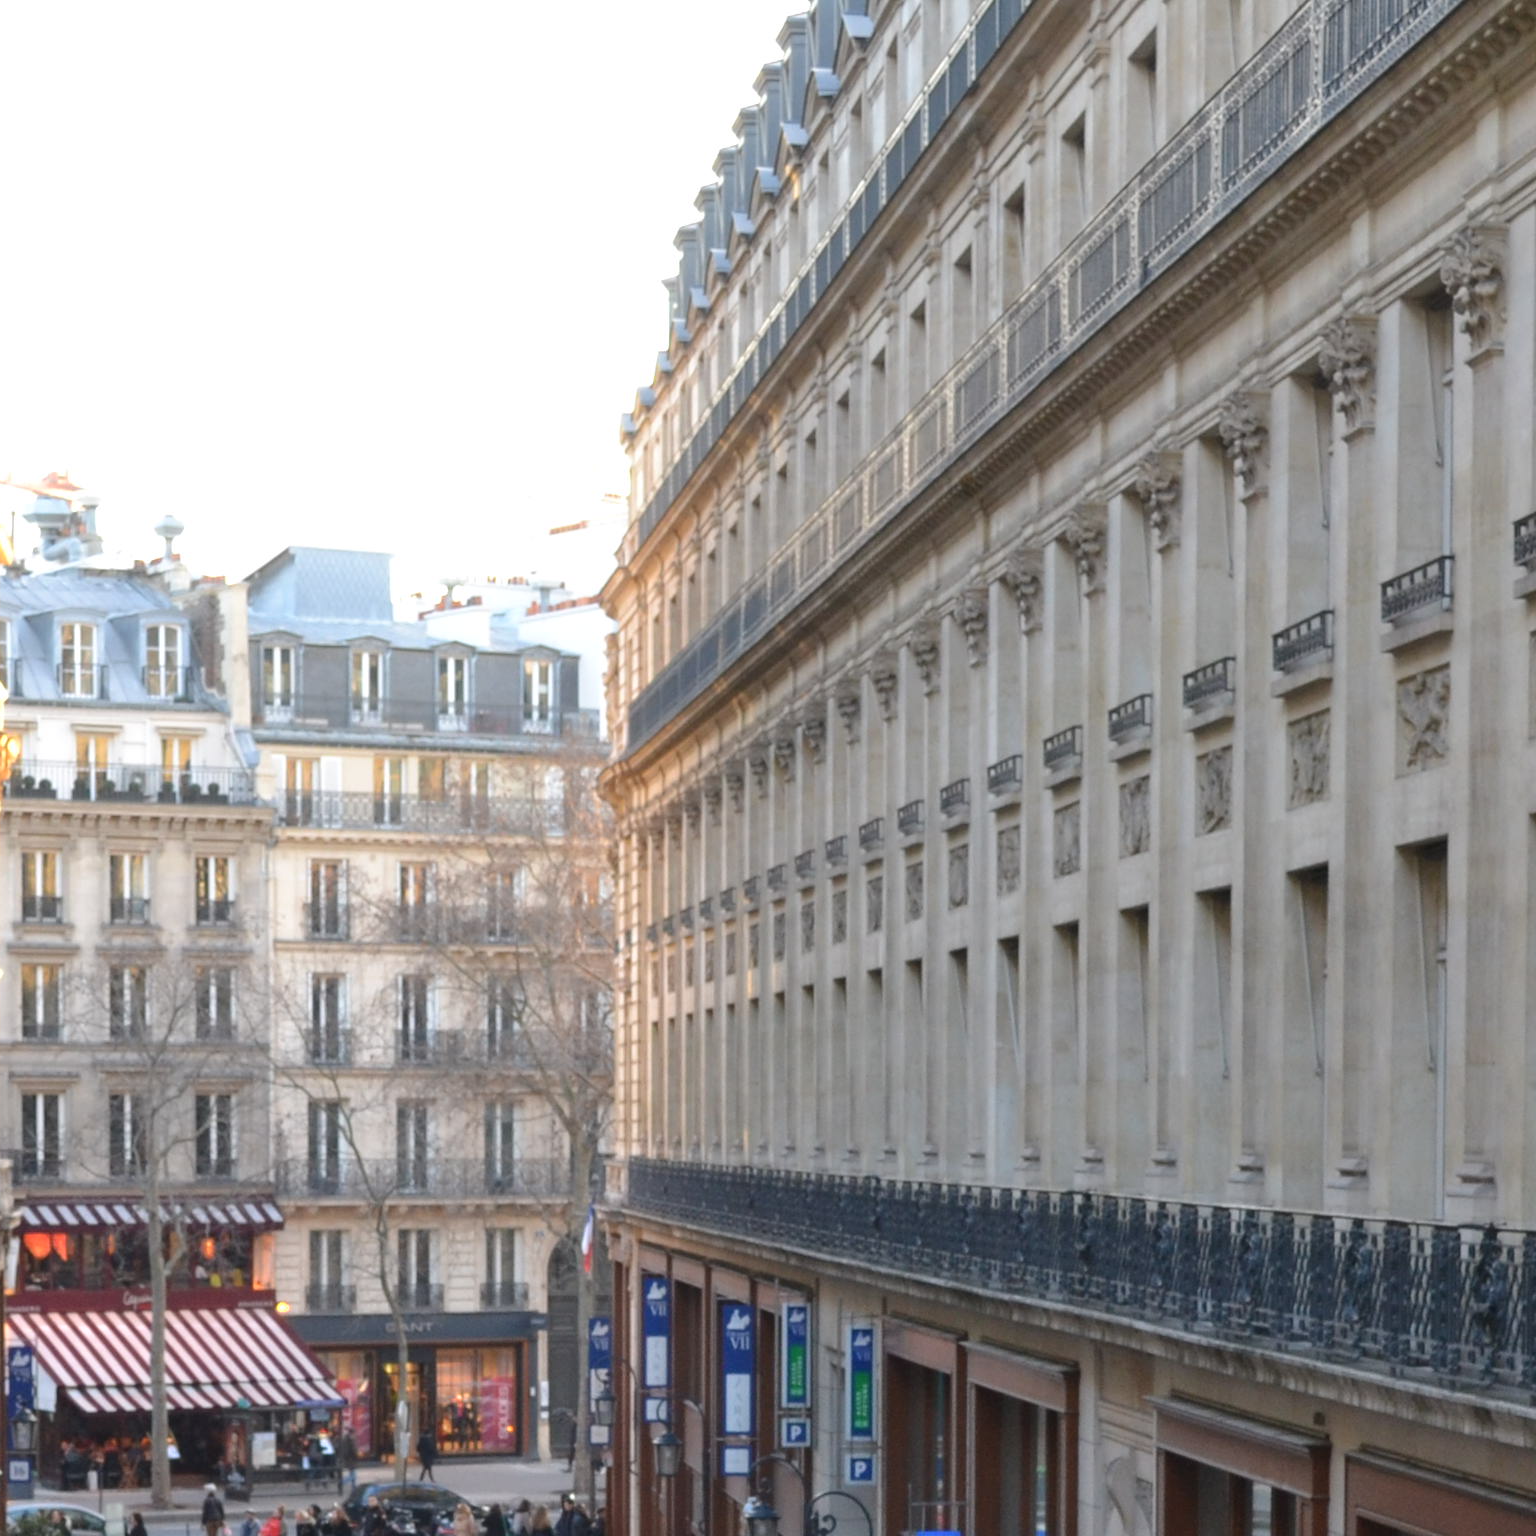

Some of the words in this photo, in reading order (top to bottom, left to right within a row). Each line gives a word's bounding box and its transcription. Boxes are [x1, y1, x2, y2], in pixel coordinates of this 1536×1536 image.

[730, 1335, 750, 1350] VII
[790, 1425, 802, 1441] P
[854, 1461, 867, 1478] P
